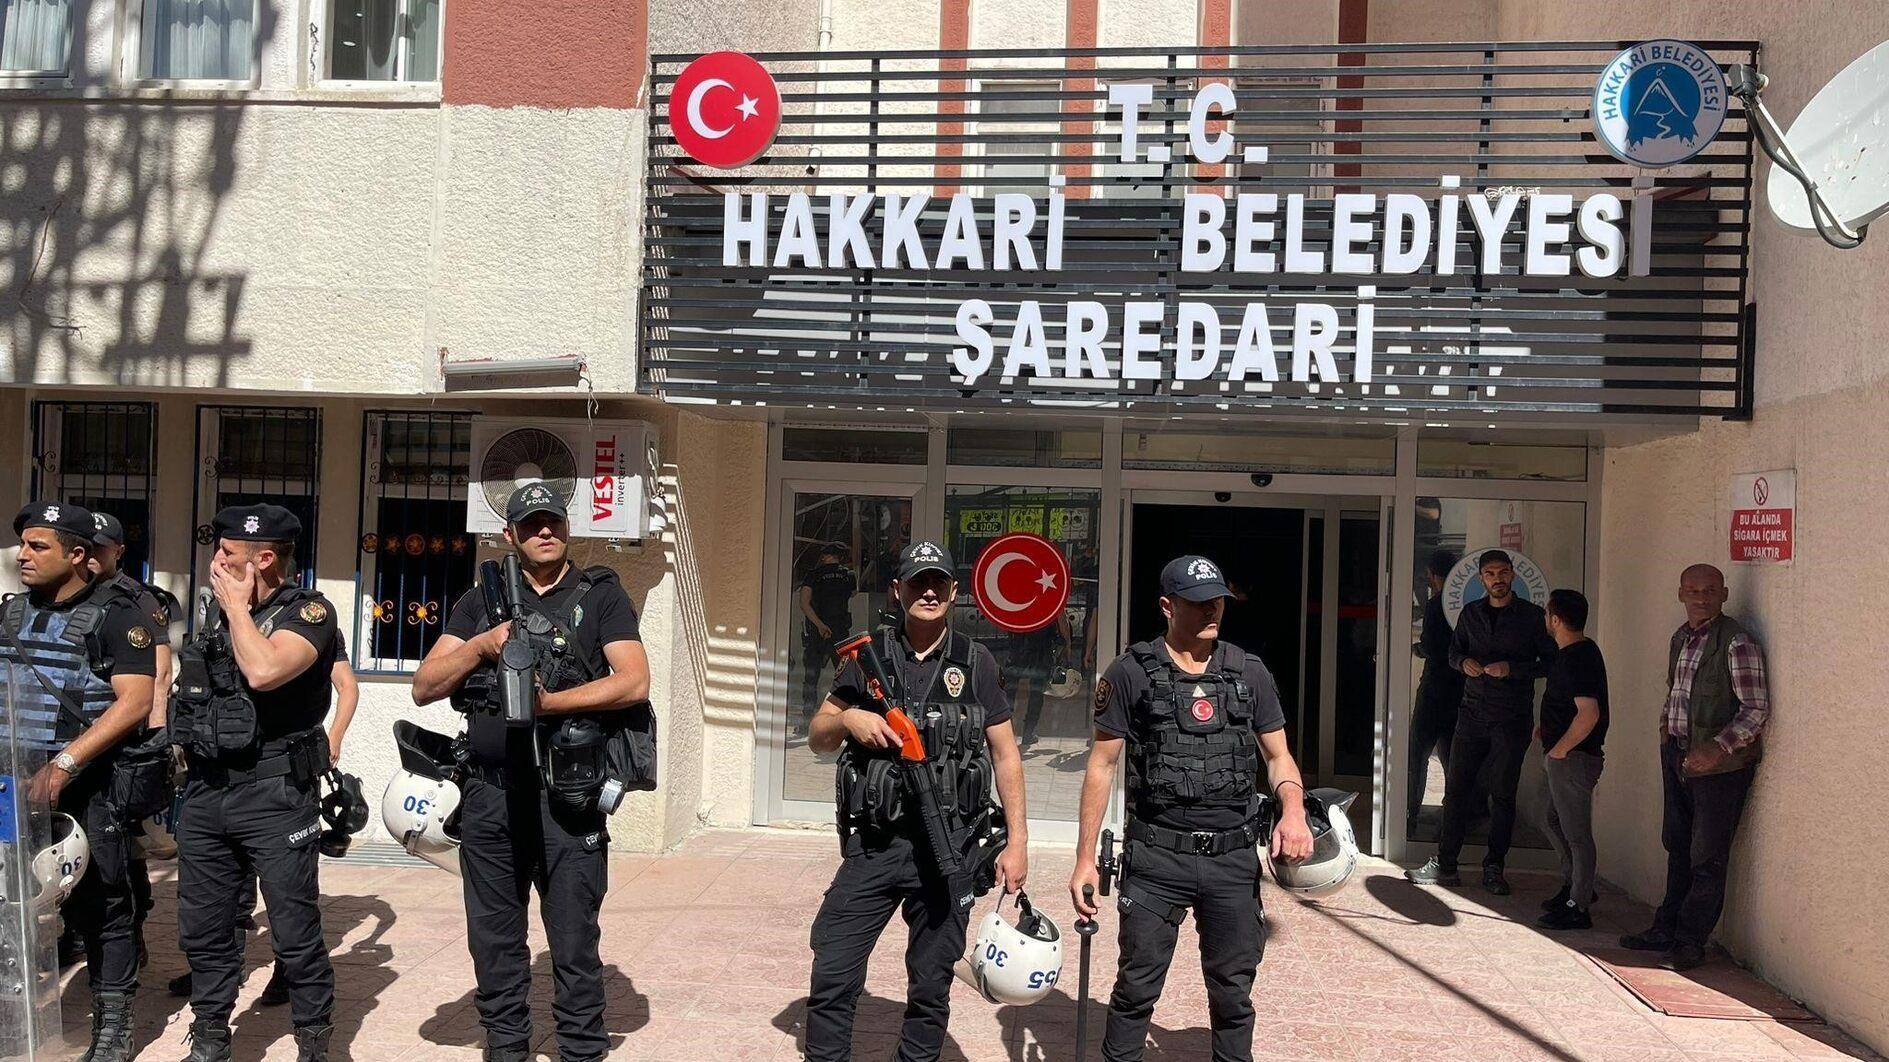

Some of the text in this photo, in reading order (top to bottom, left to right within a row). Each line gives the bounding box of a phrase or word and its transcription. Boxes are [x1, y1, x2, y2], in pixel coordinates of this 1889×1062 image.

[1602, 45, 1721, 120] HAKKARİ BELEDİYESİ
[721, 174, 1654, 278] HAKKARİ BELEDİYESİ
[952, 285, 1376, 385] ŞAREDARİ
[592, 434, 616, 522] VESTEL
[1733, 527, 1788, 544] SİGARA İÇMEK
[1739, 514, 1750, 526] BU
[1447, 556, 1480, 612] HAKKAR
[403, 795, 430, 816] 30
[986, 943, 1009, 968] 30
